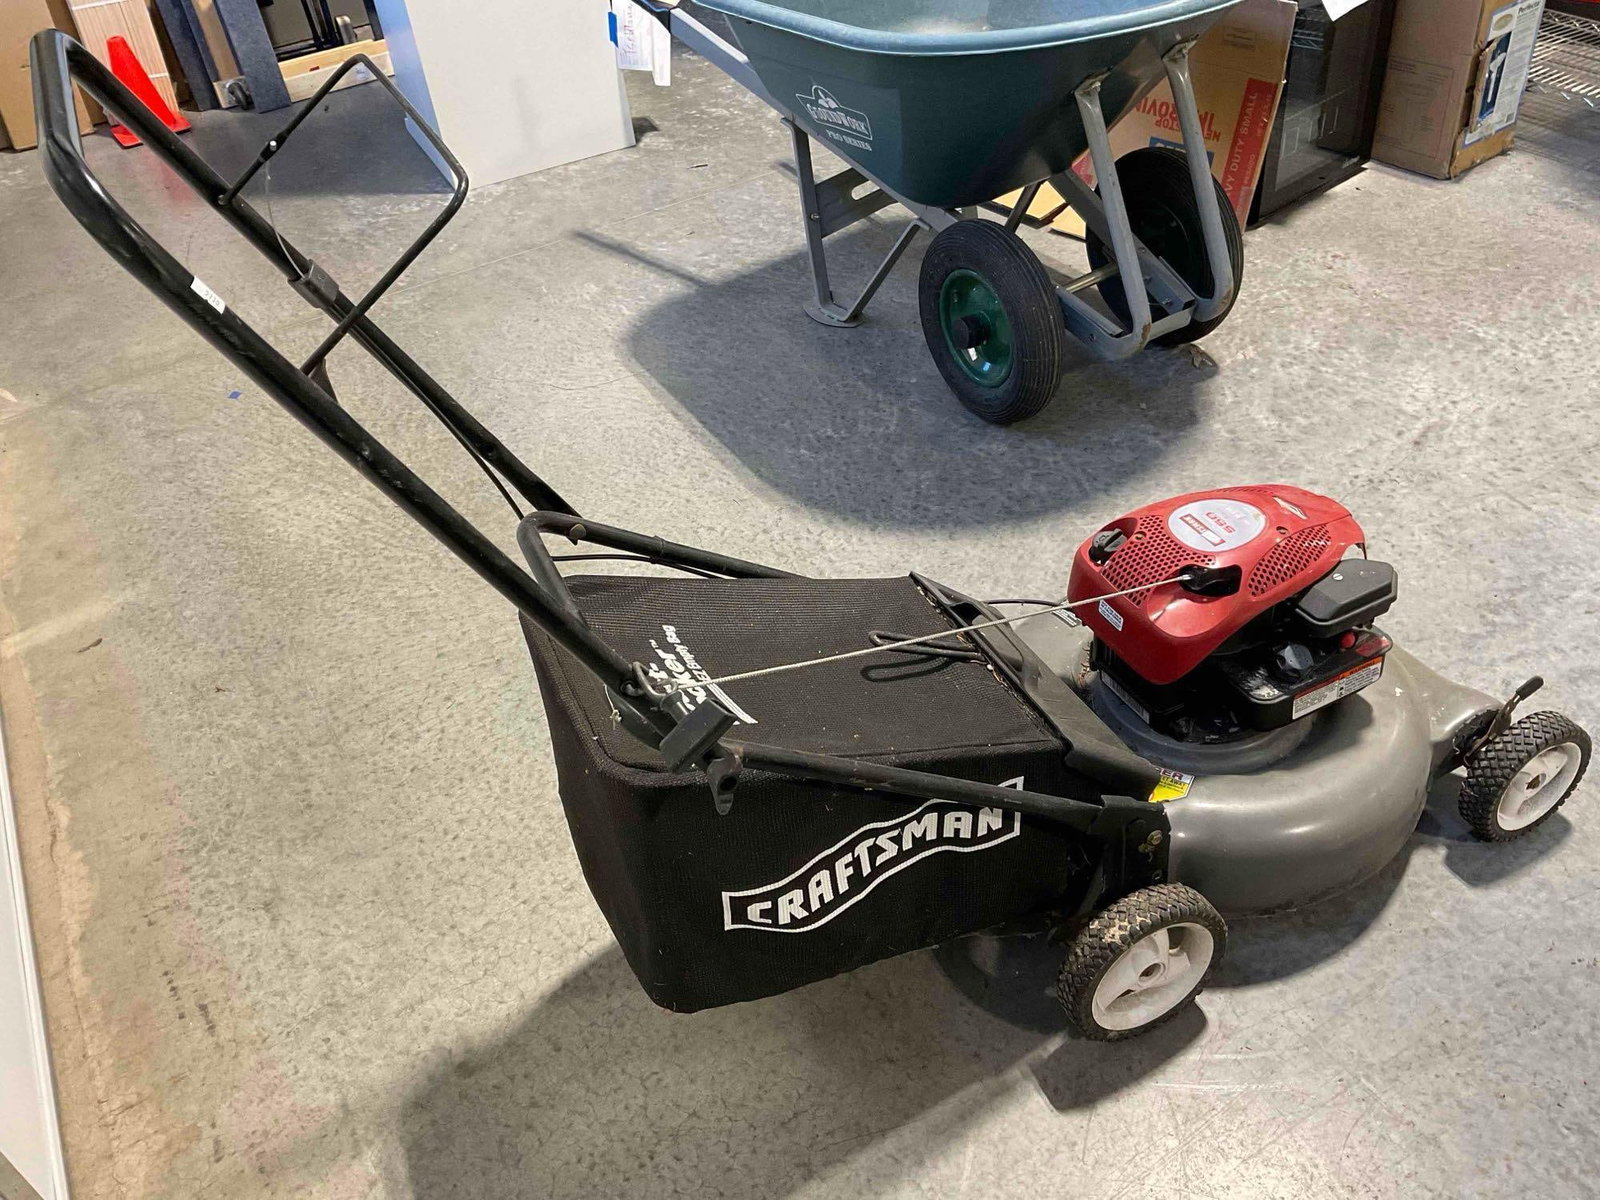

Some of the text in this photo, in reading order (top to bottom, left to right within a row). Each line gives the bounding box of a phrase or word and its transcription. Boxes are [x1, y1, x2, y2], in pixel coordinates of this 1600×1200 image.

[1231, 138, 1245, 171] DUTY
[662, 625, 681, 643] Bag
[747, 807, 1002, 925] CRAFTSMAN
